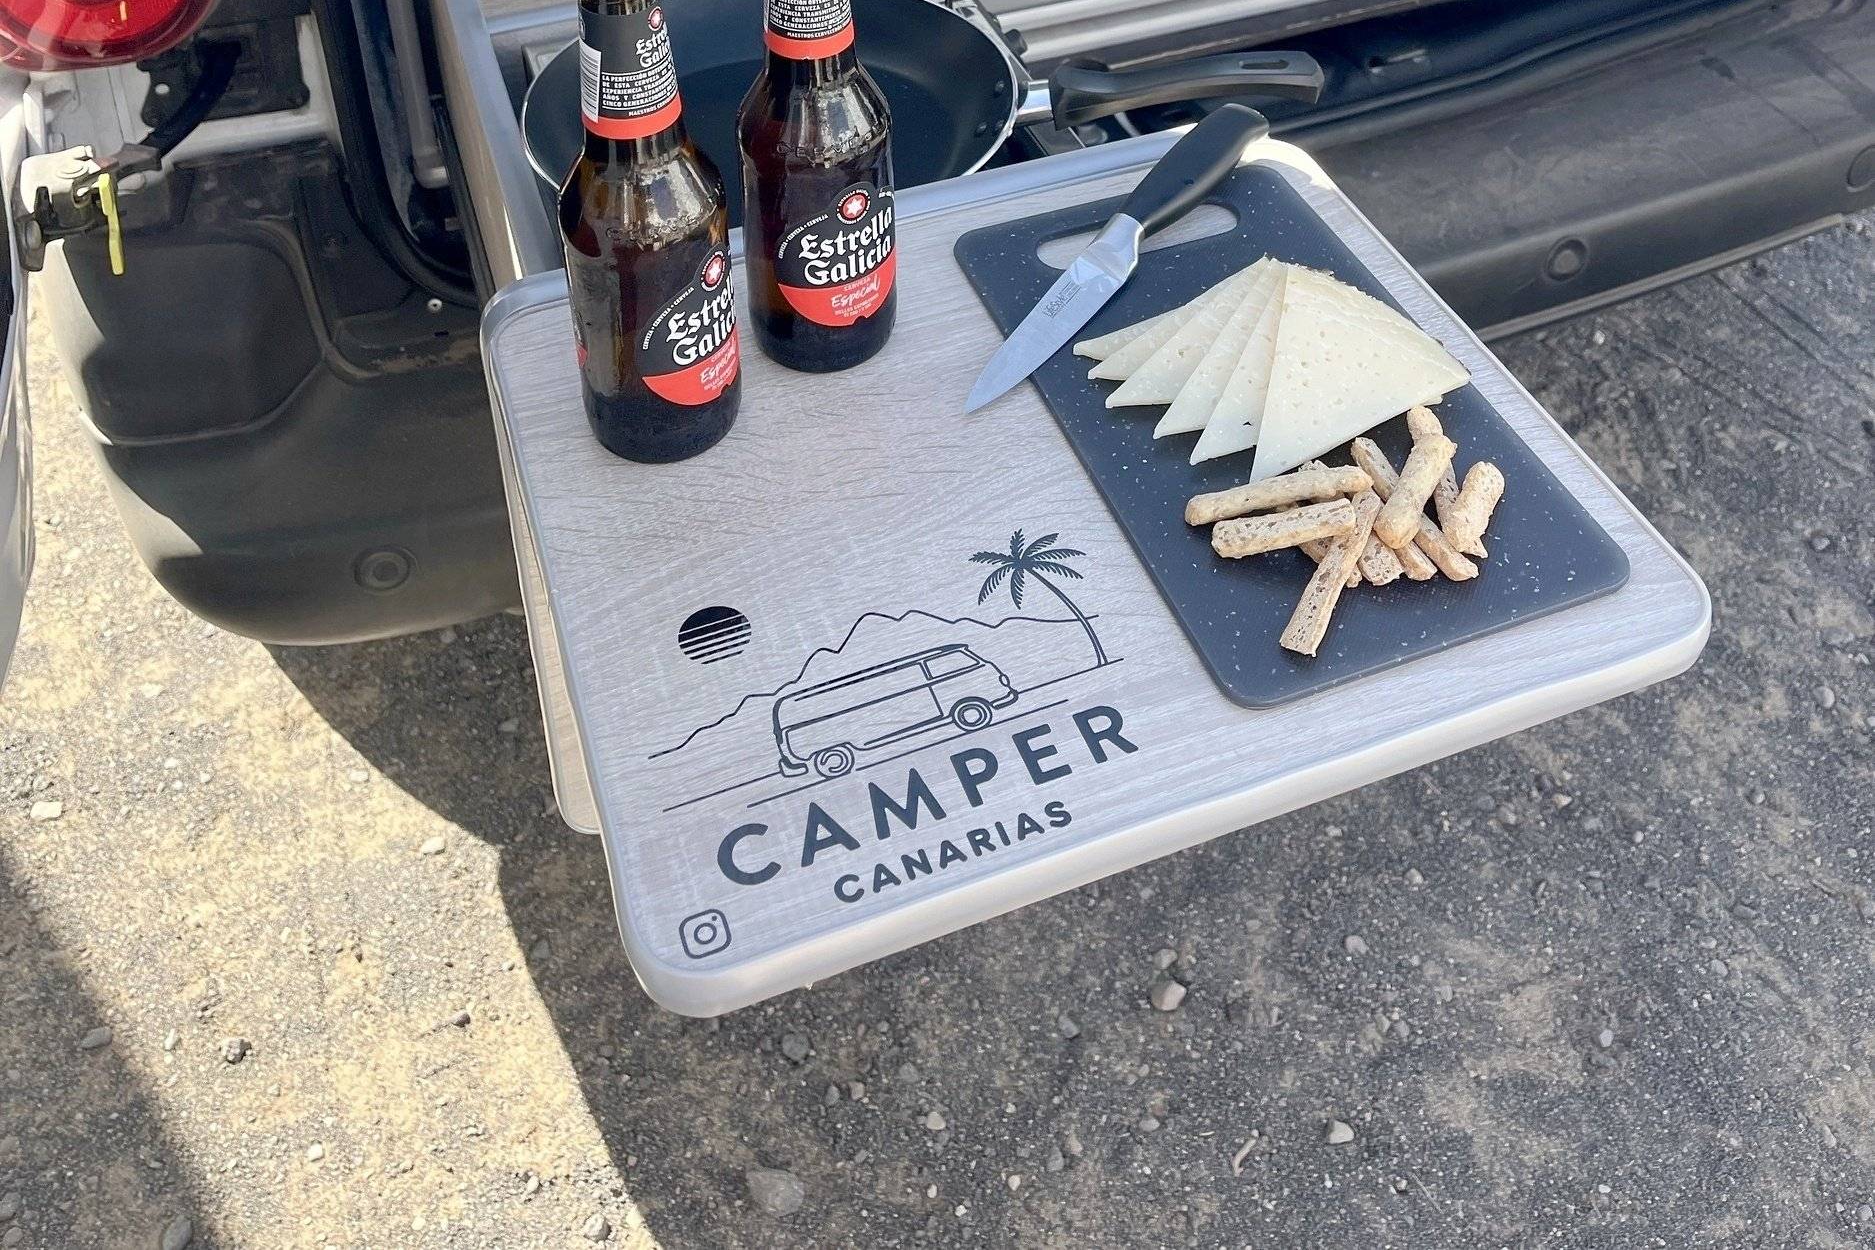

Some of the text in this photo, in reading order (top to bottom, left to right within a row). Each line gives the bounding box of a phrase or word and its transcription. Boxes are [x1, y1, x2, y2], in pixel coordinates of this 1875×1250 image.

[794, 4, 821, 12] CERVEZA
[602, 99, 622, 108] CINCO
[798, 206, 892, 260] Estrella
[803, 235, 892, 286] Galicia
[831, 274, 880, 308] Especial
[716, 704, 1140, 887] CAMPER
[832, 800, 1073, 904] CANARIAS
